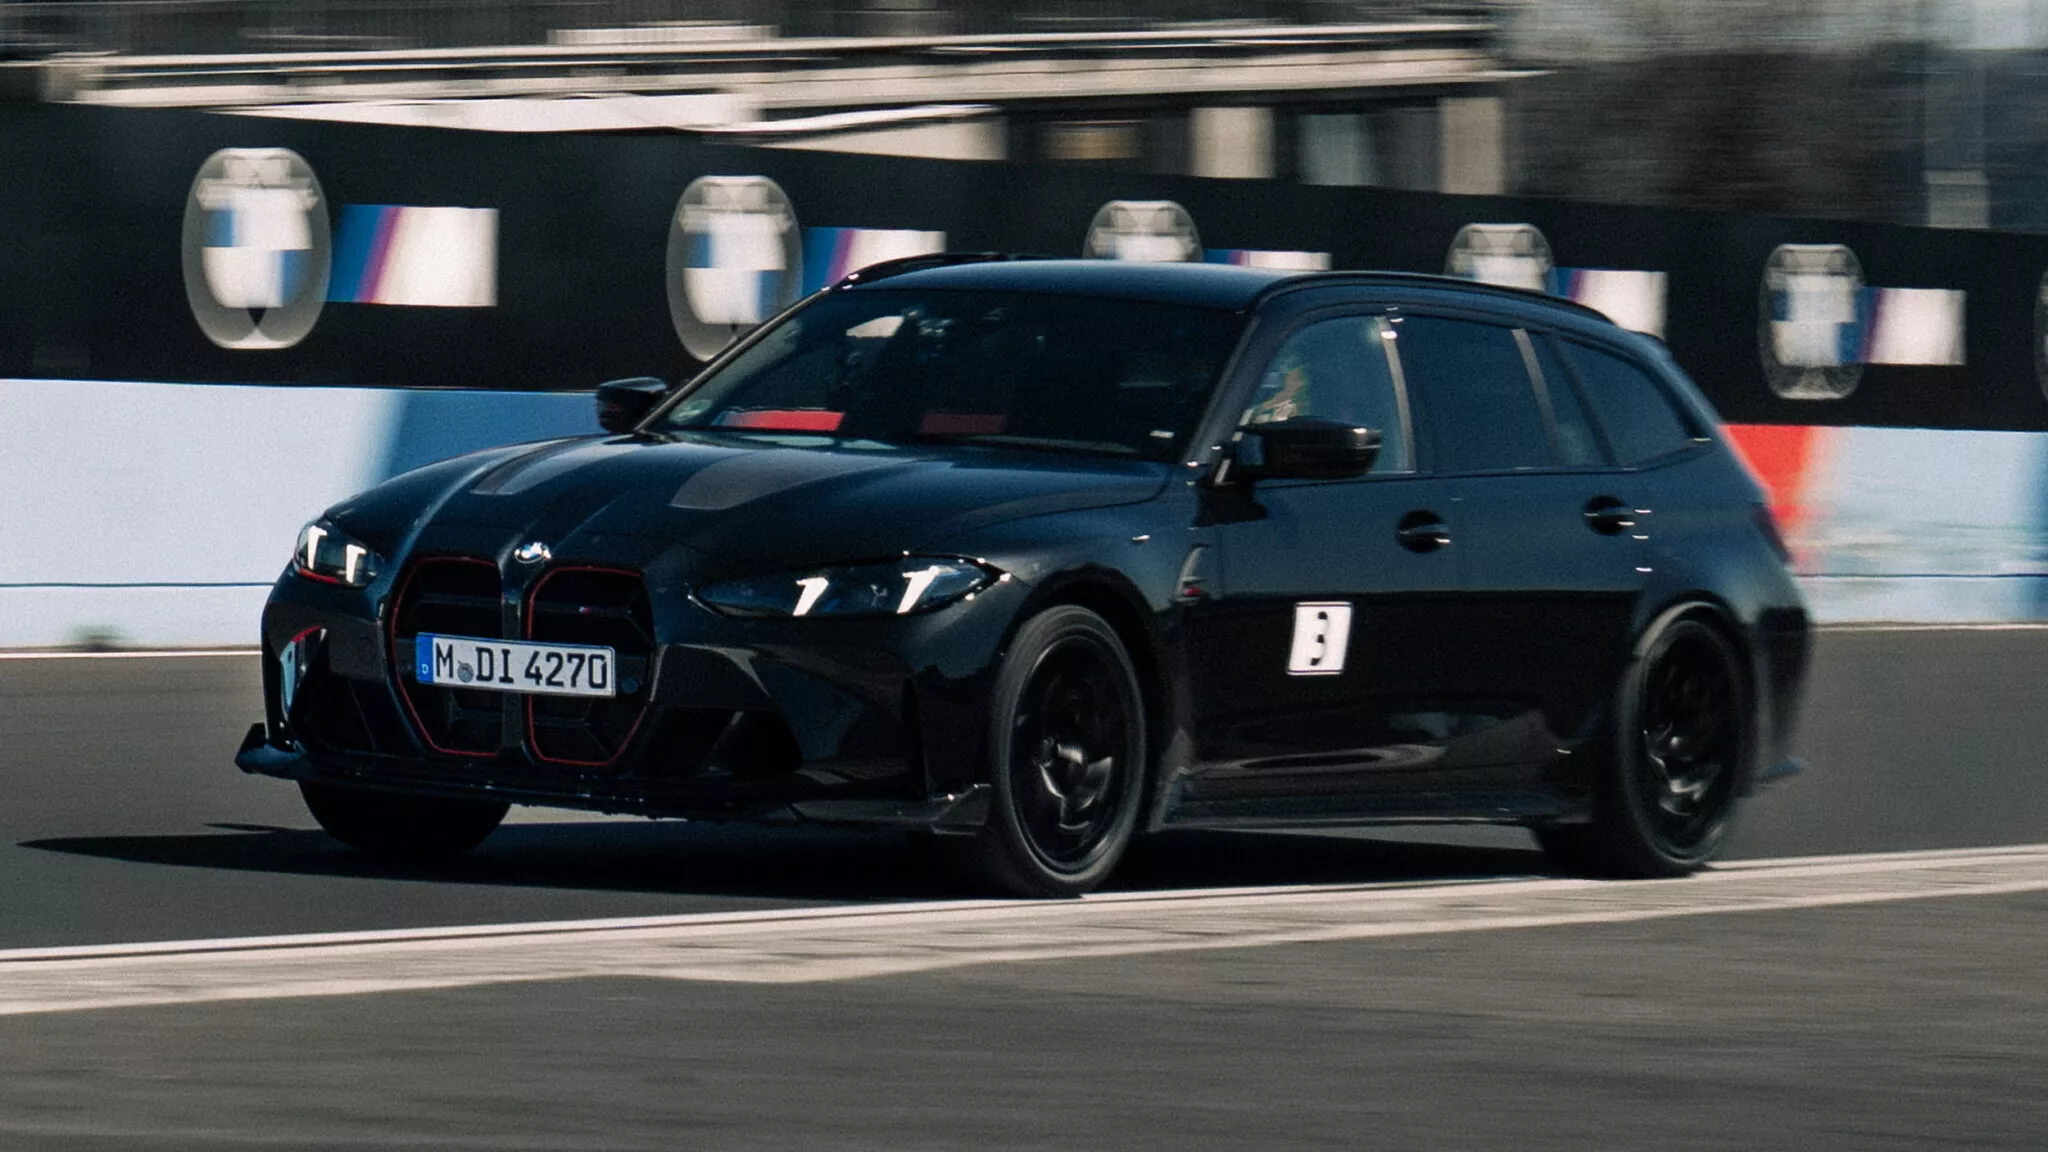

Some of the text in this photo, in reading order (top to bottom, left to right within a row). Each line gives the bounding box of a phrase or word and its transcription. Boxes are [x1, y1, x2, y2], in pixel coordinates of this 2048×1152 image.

[421, 663, 429, 674] D
[435, 643, 607, 689] M DI 4270
